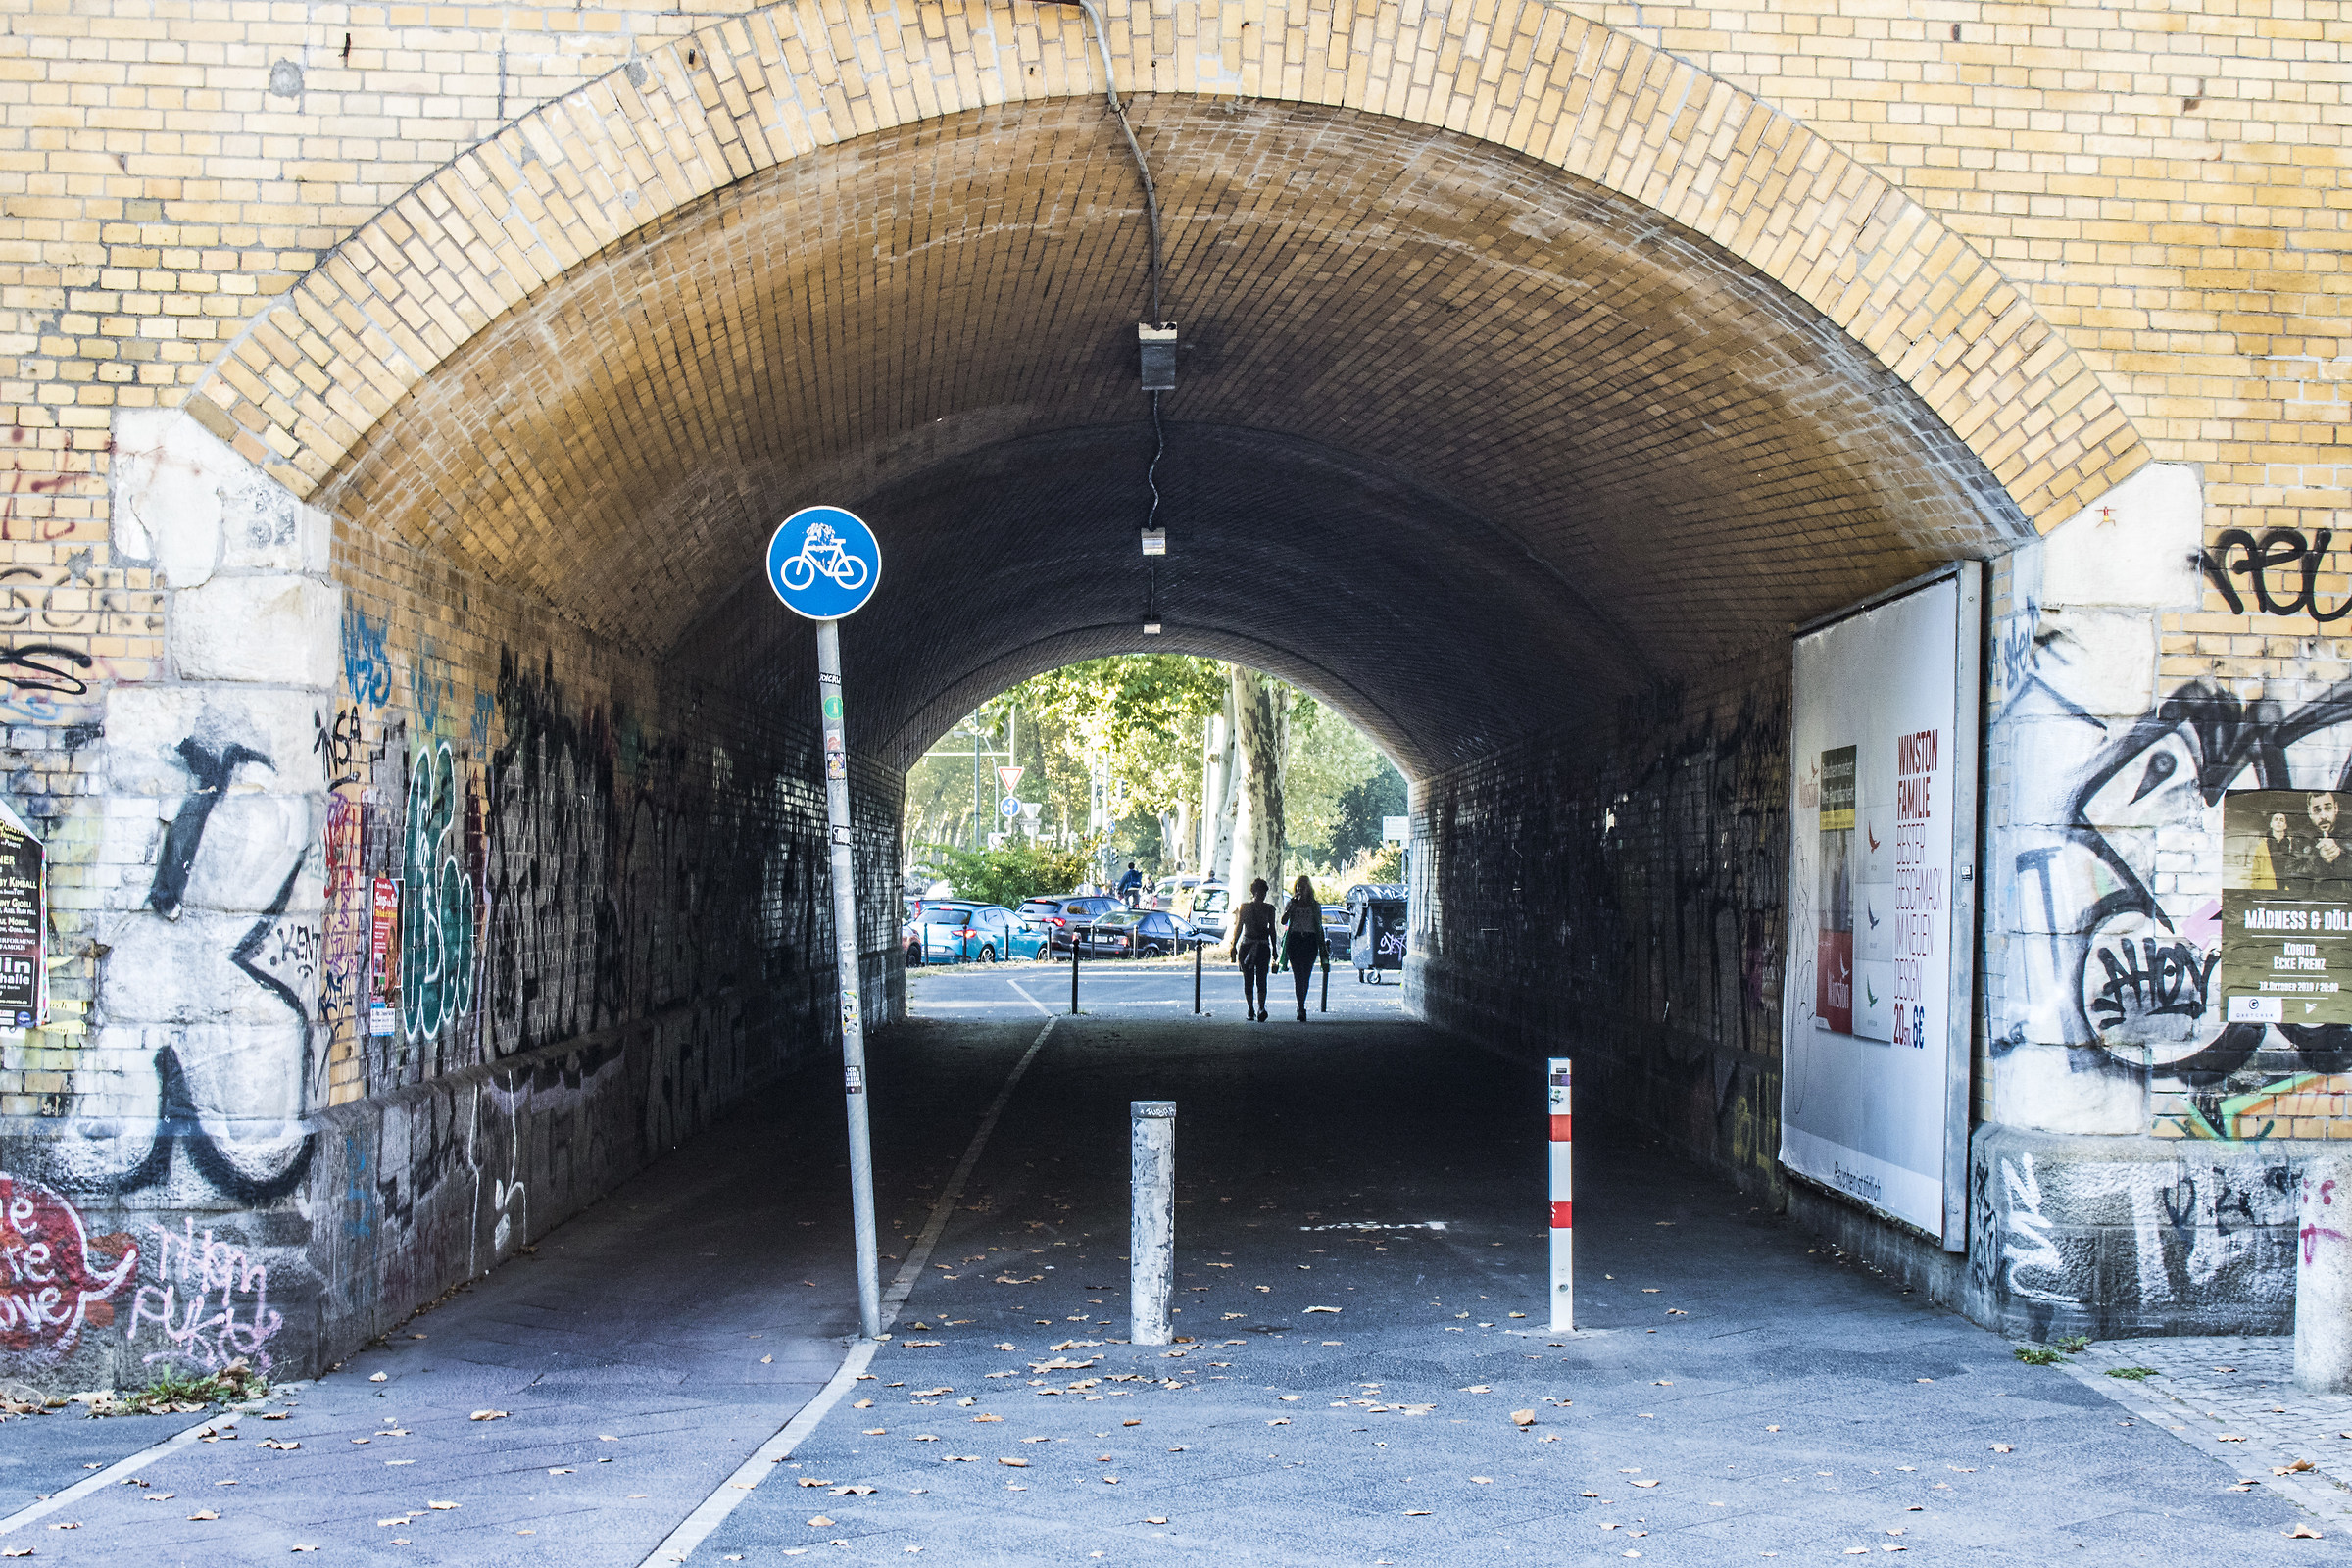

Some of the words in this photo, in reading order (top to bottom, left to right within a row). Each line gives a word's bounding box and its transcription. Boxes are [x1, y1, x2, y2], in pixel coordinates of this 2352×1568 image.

[1898, 729, 1937, 776] WINSTON
[1898, 776, 1931, 820] FAMILIE
[1897, 823, 1925, 864] BESTER
[9, 876, 37, 889] KIMBALL
[1896, 868, 1942, 910] GESCHMACK
[1895, 913, 1903, 955] IM
[1905, 913, 1935, 956] NEUEN
[2244, 907, 2307, 930] MÄDNESS
[2310, 911, 2321, 930] &
[1828, 967, 1849, 1009] Winston
[1895, 958, 1922, 1001] DESIGN
[2097, 938, 2222, 1010] AHOY
[1913, 1004, 1925, 1050] 6€
[1834, 1161, 1856, 1193] Rauchen
